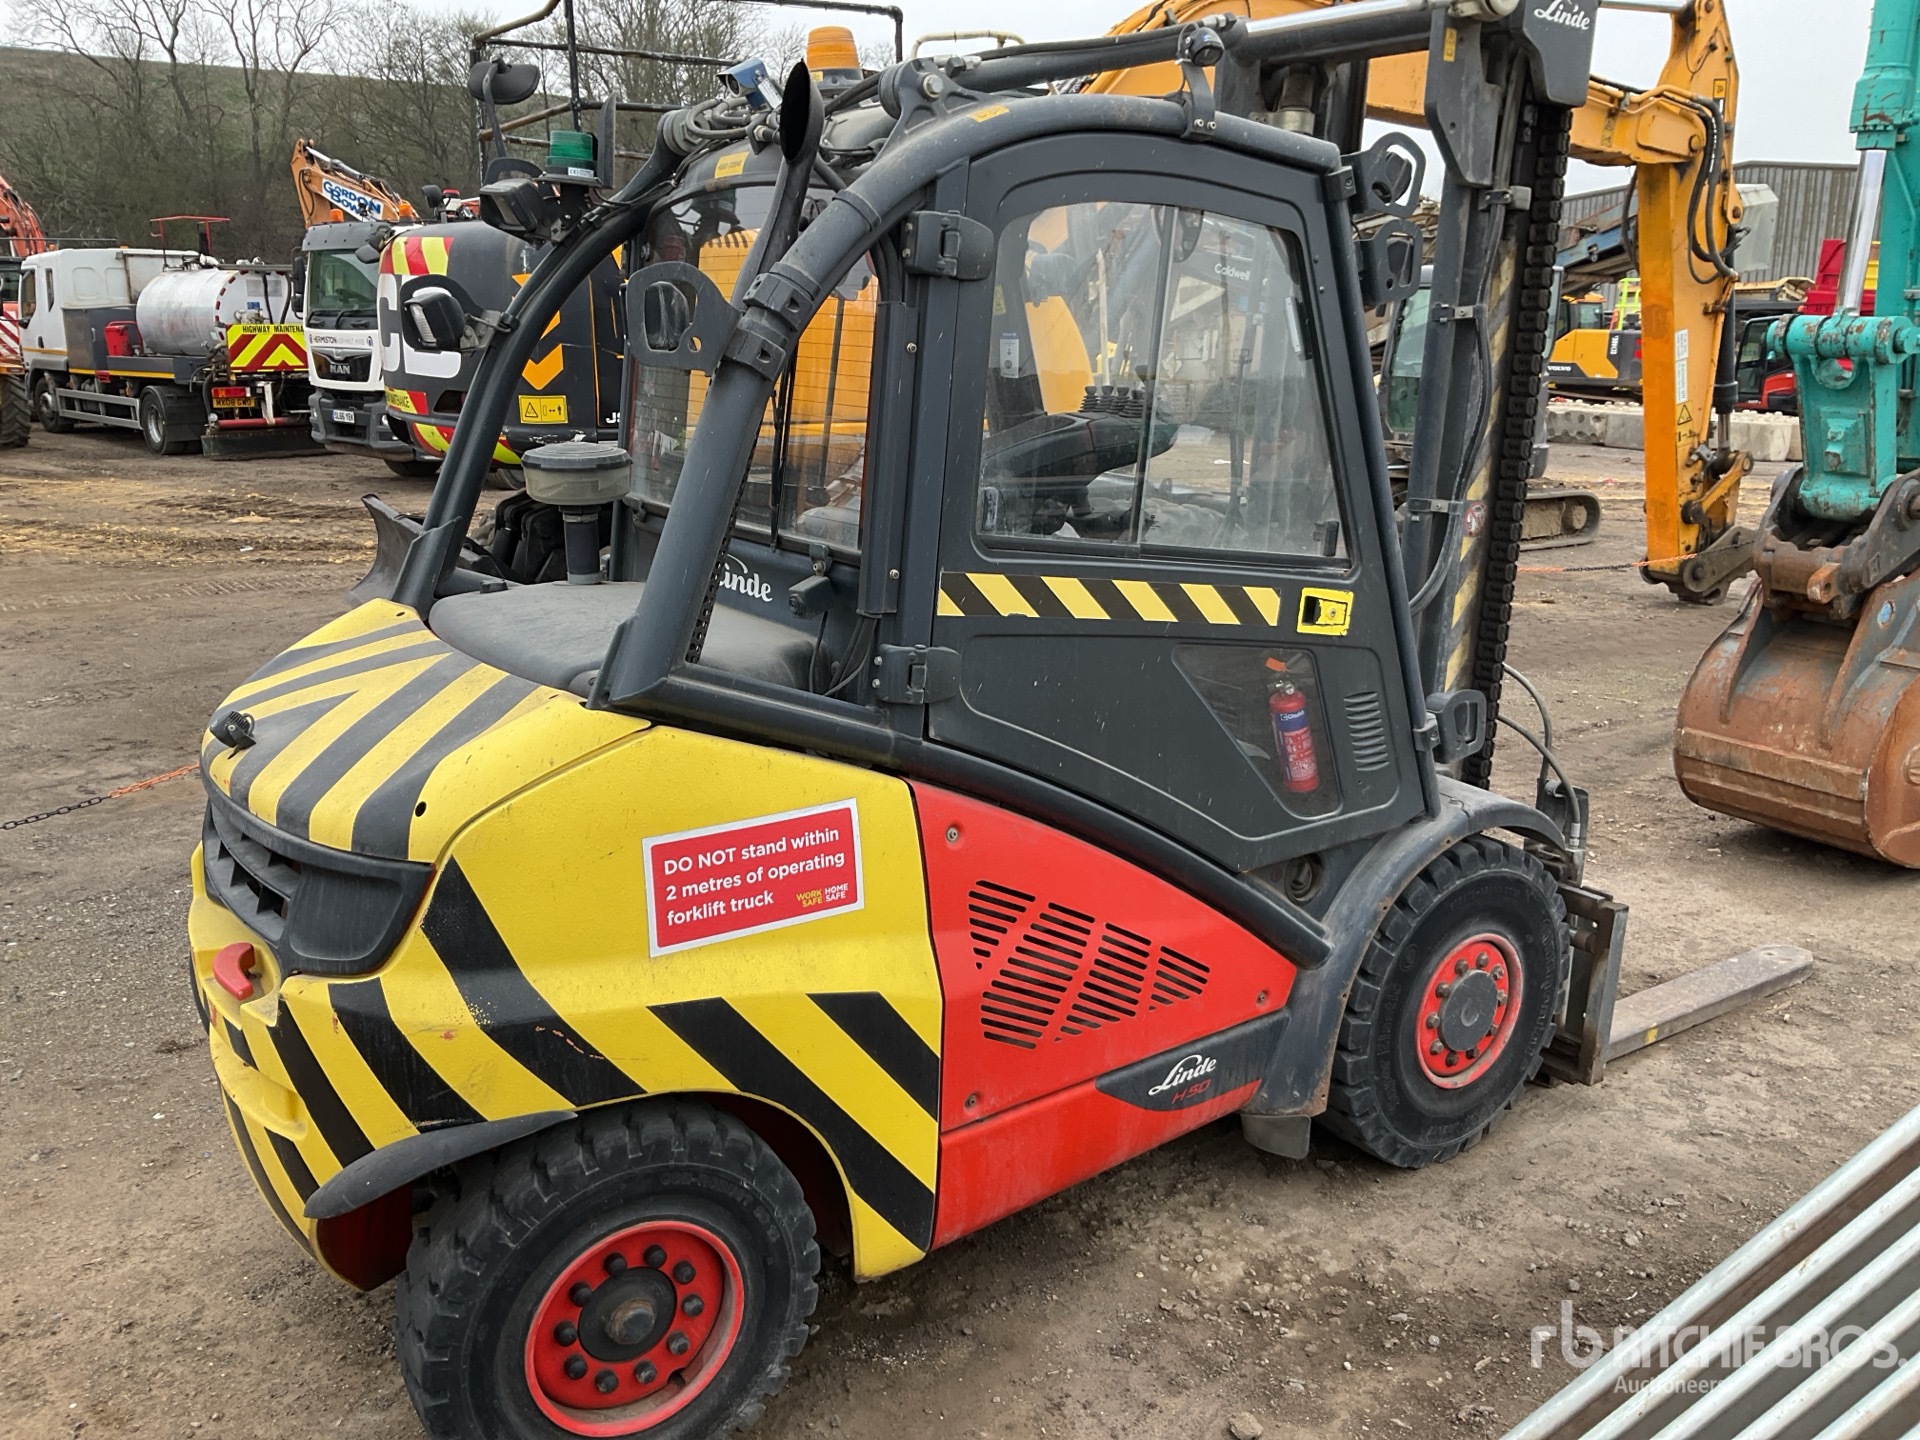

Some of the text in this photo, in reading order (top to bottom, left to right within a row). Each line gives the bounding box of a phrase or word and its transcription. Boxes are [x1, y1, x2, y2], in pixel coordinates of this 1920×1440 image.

[1534, 0, 1590, 30] Linde
[323, 181, 381, 214] GORDON
[242, 325, 270, 333] HIGHWAY
[330, 364, 350, 374] MAN
[664, 828, 839, 875] DO NOT stand within
[666, 852, 845, 901] 2 metres of operating
[825, 883, 849, 895] HOME
[667, 890, 774, 926] forklift truck
[796, 889, 822, 901] WORK
[802, 897, 823, 908] SAFE
[826, 891, 846, 902] SAFE
[1148, 1054, 1217, 1096] Linde
[1171, 1079, 1212, 1105] H50
